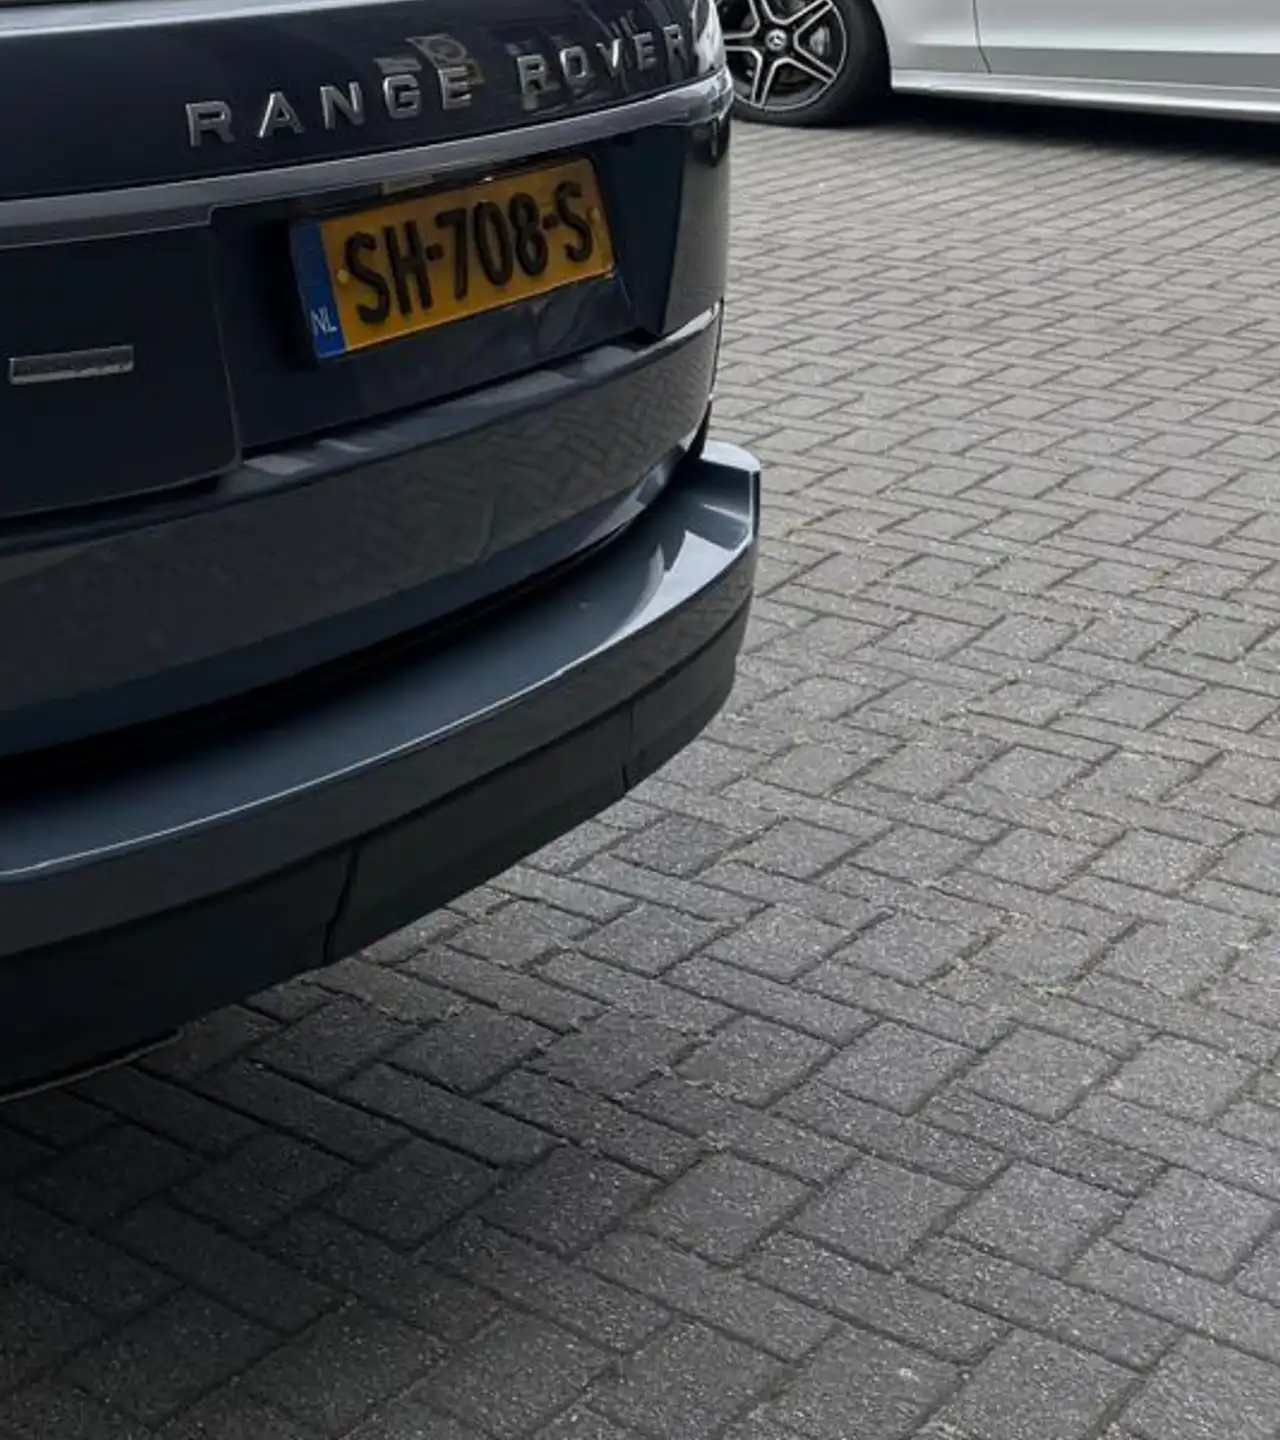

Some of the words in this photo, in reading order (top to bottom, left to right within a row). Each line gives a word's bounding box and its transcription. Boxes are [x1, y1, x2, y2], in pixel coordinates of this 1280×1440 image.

[185, 65, 472, 147] RANGE
[516, 23, 690, 102] ROVER
[343, 180, 593, 324] SH-708-S
[310, 306, 337, 337] NL
